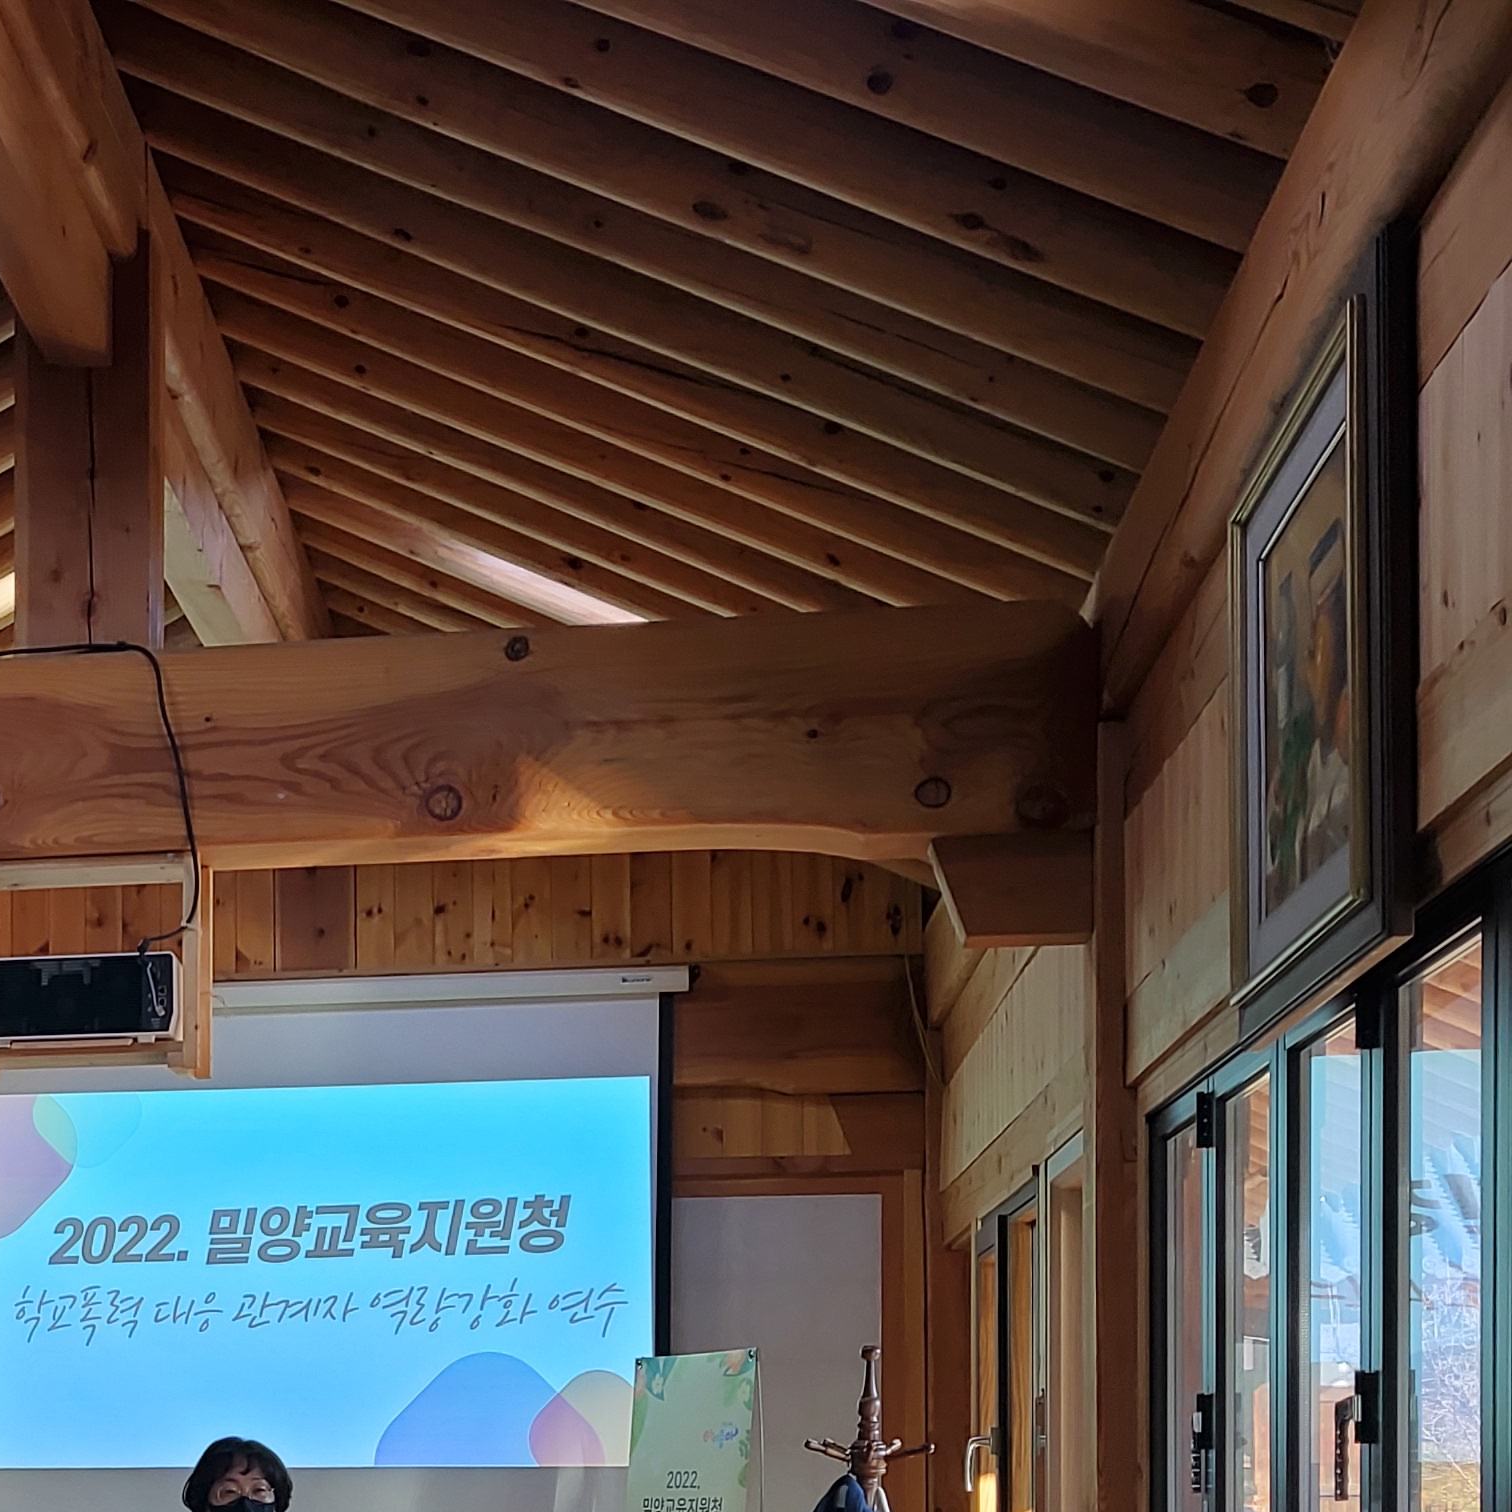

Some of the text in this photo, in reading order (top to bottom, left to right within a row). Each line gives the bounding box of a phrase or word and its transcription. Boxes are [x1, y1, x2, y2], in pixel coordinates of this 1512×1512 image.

[48, 1194, 572, 1266] 2022. 밀양교육지원청
[15, 1277, 630, 1347] 학교폭력 대응 관계자 역량강화 연수
